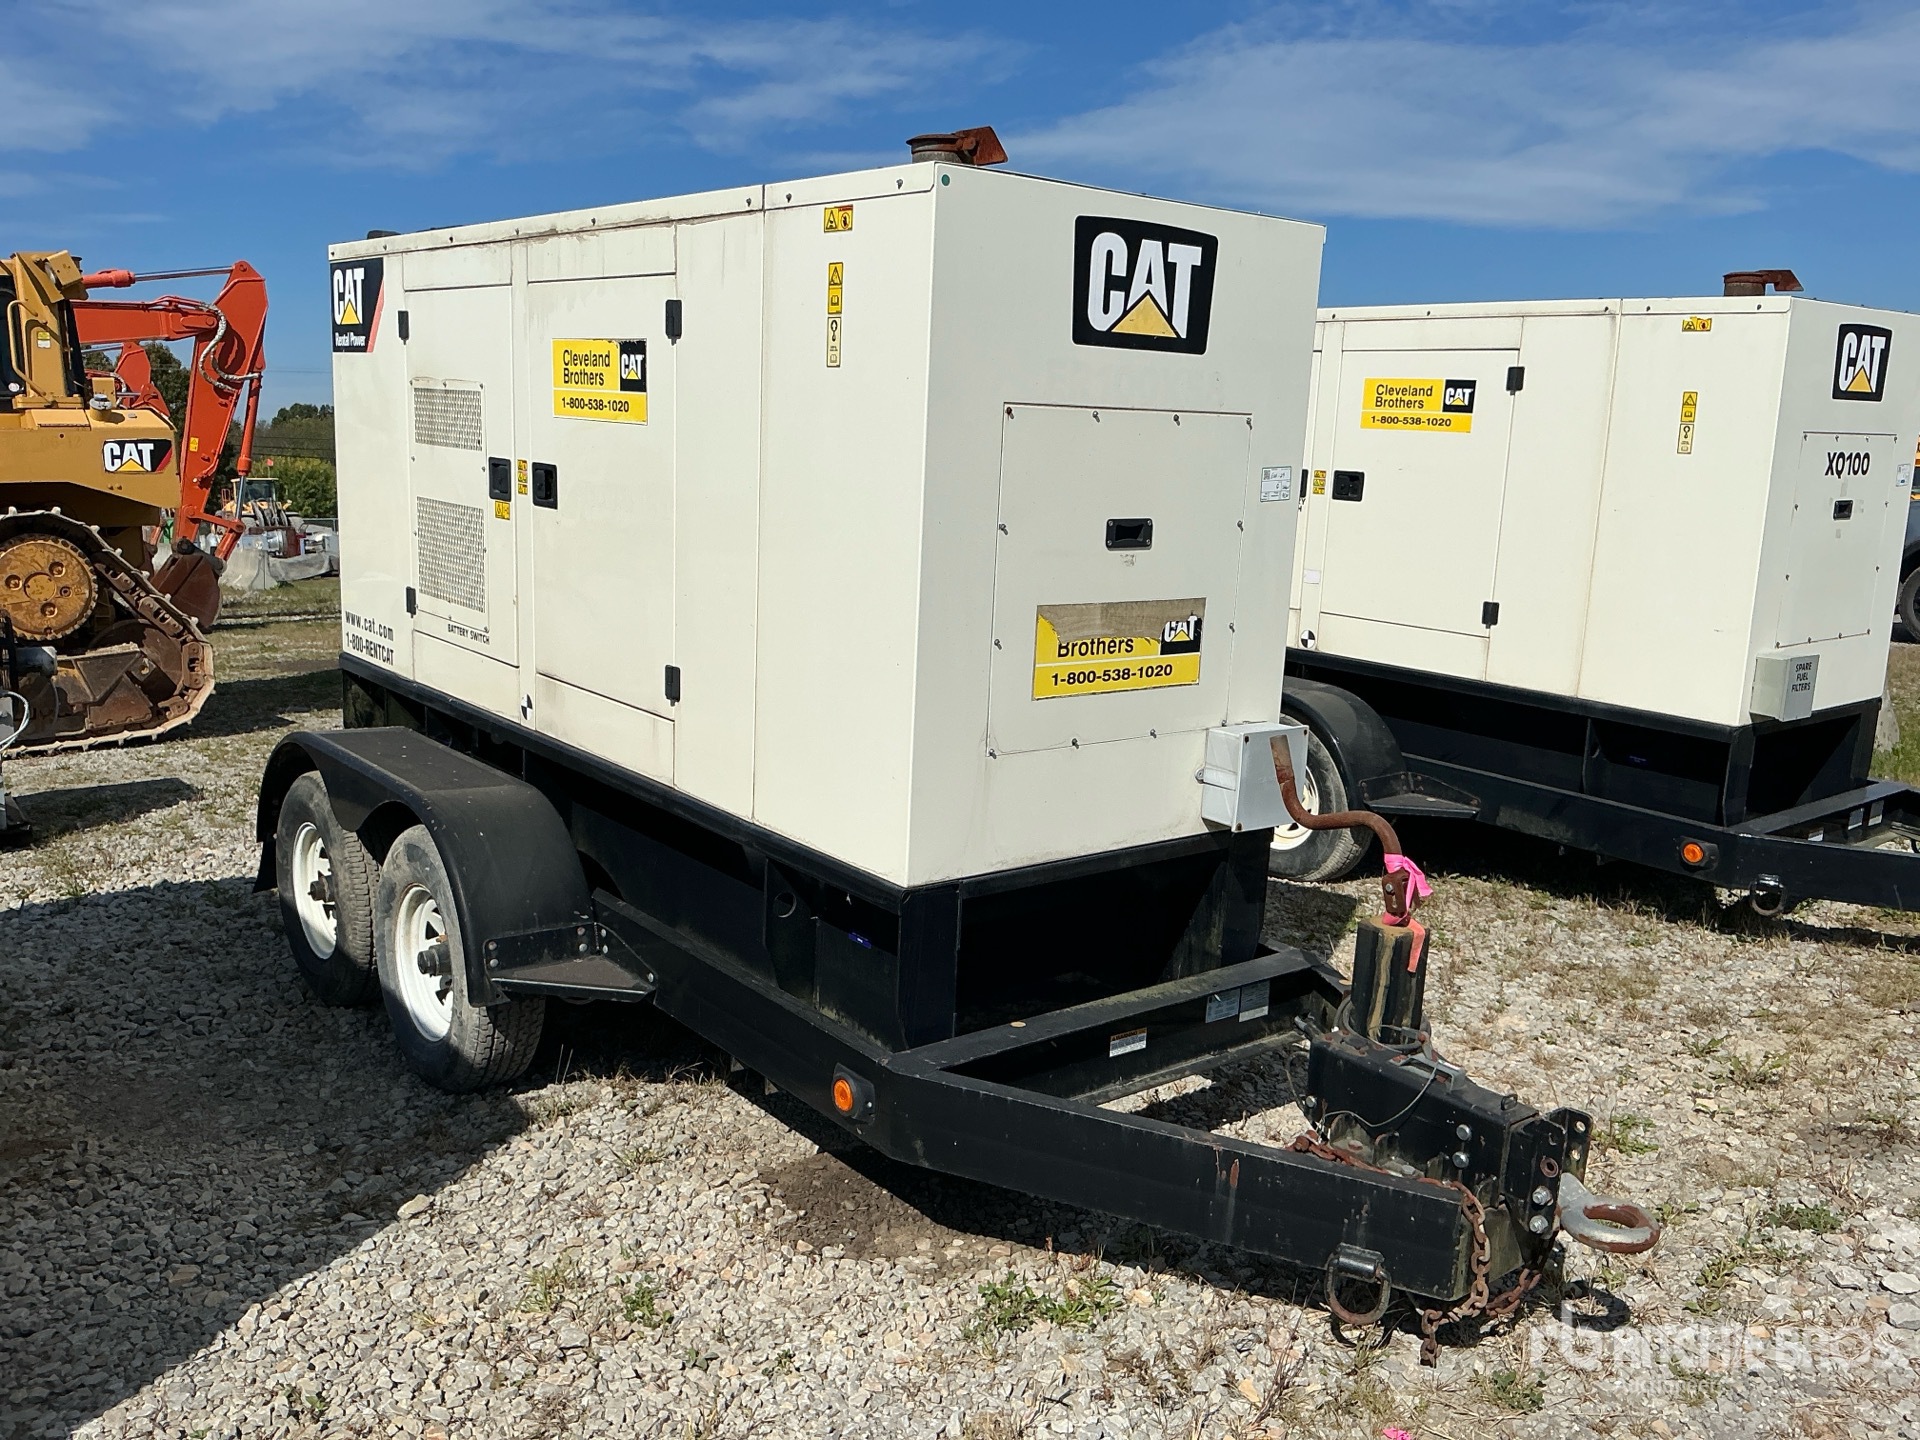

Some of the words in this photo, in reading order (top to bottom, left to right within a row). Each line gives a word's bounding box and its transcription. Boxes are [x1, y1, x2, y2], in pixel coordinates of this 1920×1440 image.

[1087, 232, 1203, 339] CAT
[333, 268, 365, 325] CAT
[563, 349, 611, 367] Cleveland
[621, 353, 645, 380] CAT
[1838, 332, 1886, 393] CAT
[563, 368, 605, 386] Brothers
[1376, 384, 1434, 397] Cleveland
[1445, 387, 1474, 406] CAT
[561, 397, 630, 413] 1-800-538-1020
[1375, 396, 1425, 409] Brothers
[1370, 415, 1452, 427] 1-800-538-1020
[103, 442, 154, 472] CAT
[1825, 452, 1871, 479] XQ100
[345, 610, 394, 642] www.cat.com
[447, 623, 470, 638] BATTERY
[470, 630, 491, 645] SWITCH
[1164, 615, 1198, 643] CAT
[345, 631, 395, 666] 1-800-RENTCAT
[1057, 637, 1134, 658] Brothers
[1051, 664, 1173, 686] 1-800-538-1020
[1795, 662, 1812, 673] SPARE
[1796, 672, 1809, 682] FUEL
[1791, 682, 1811, 692] FILTERS
